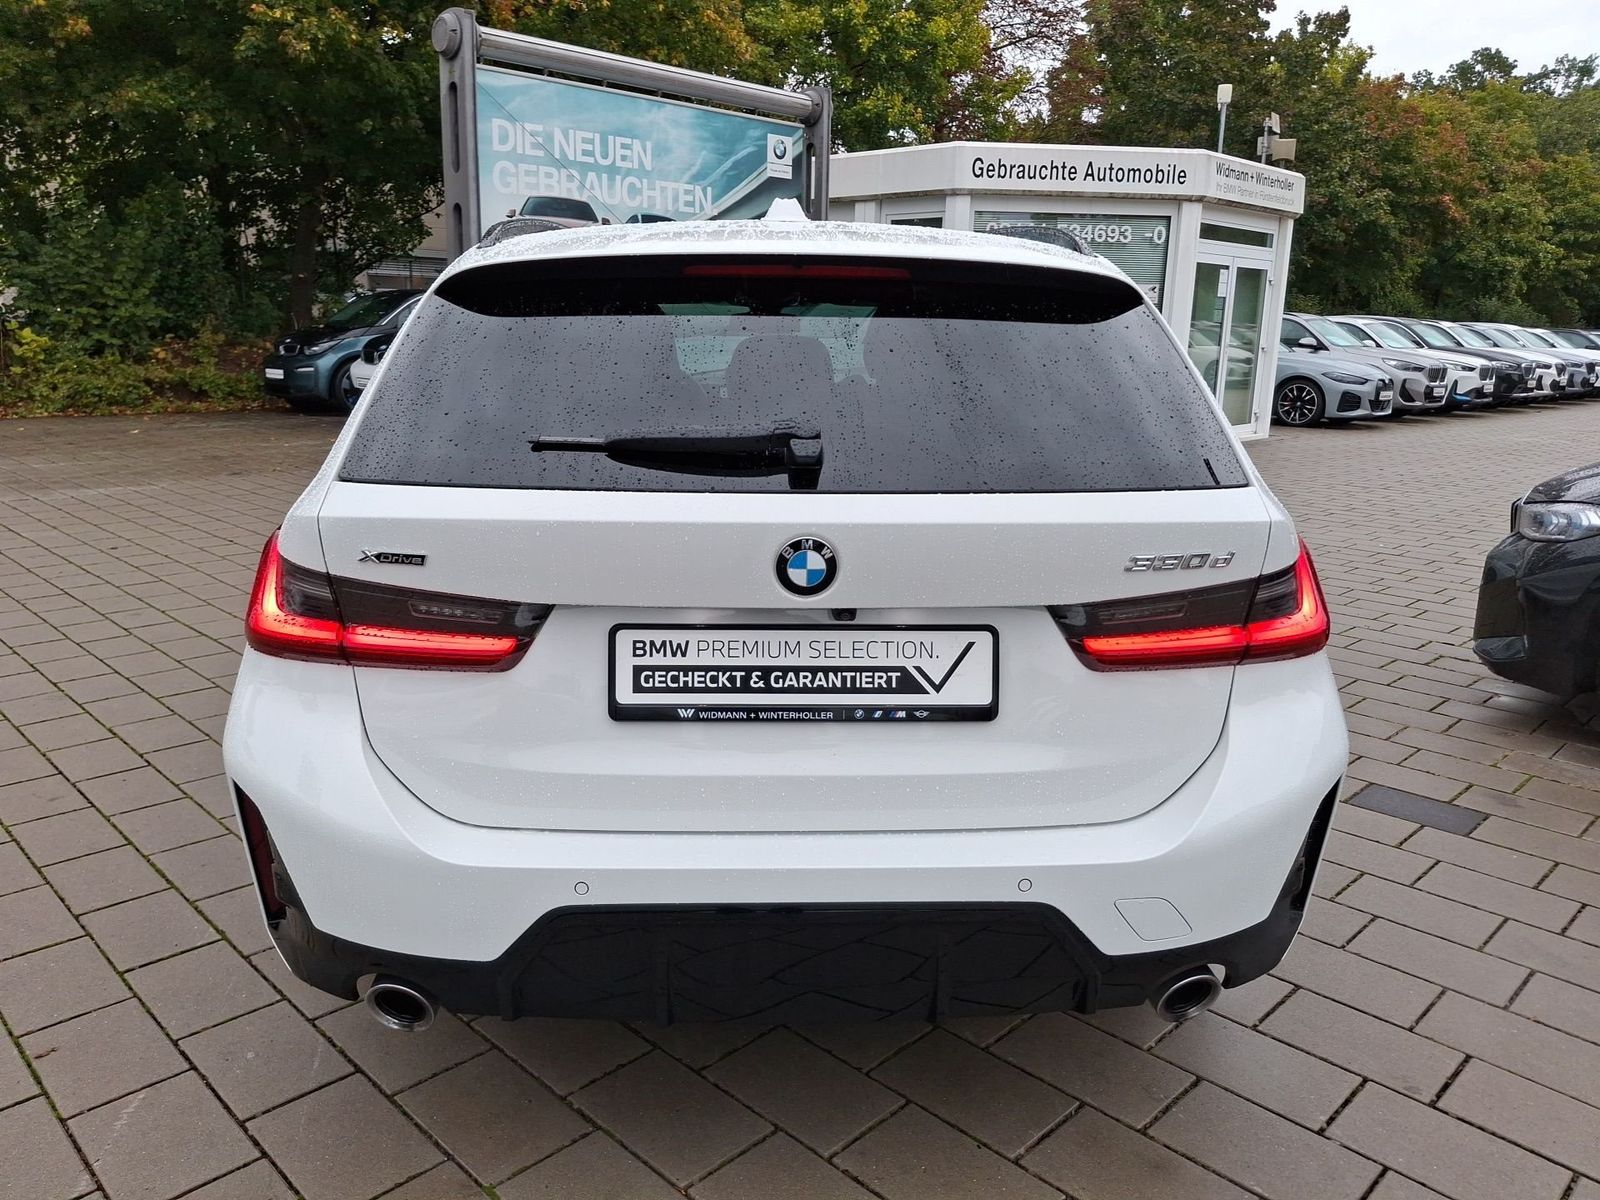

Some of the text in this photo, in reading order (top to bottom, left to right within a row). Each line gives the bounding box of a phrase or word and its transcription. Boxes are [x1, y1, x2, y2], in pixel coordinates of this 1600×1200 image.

[491, 118, 652, 171] DIE NEUEN
[971, 157, 1187, 184] Gebrauchte Automobile
[1215, 161, 1249, 182] Widmann
[1256, 171, 1295, 192] Winterholler
[781, 539, 833, 560] BMW
[631, 640, 940, 660] BMW PREMIUM SELECTION.
[640, 671, 901, 689] GECHECKT & GARANTIERT
[698, 711, 747, 720] WIDMANN
[758, 711, 834, 720] WINTERHOLLER
